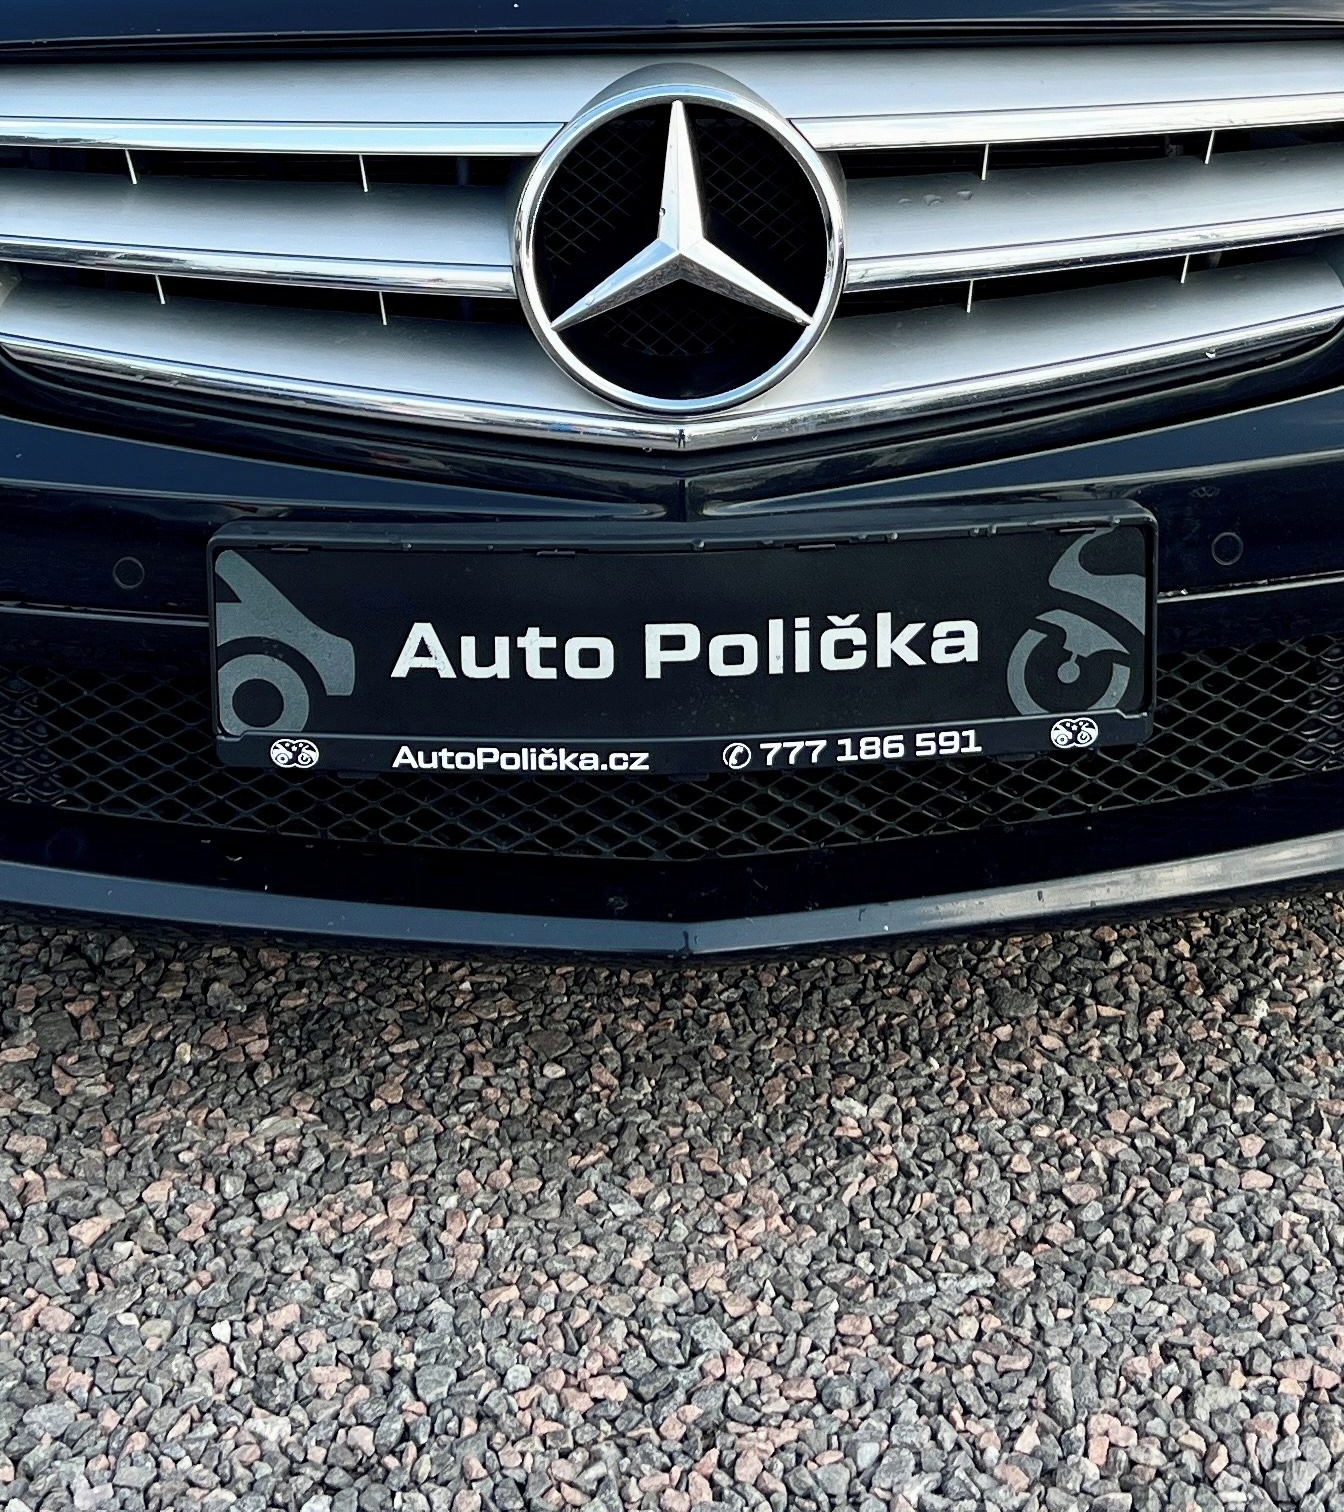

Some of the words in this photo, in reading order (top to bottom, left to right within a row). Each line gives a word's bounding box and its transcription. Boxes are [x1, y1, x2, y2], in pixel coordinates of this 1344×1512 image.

[390, 622, 615, 680] Auto
[644, 611, 979, 679] Polička
[391, 745, 650, 772] AutoPolička.cz
[759, 739, 827, 766] 777
[836, 730, 909, 762] 186
[915, 726, 983, 756] 591
